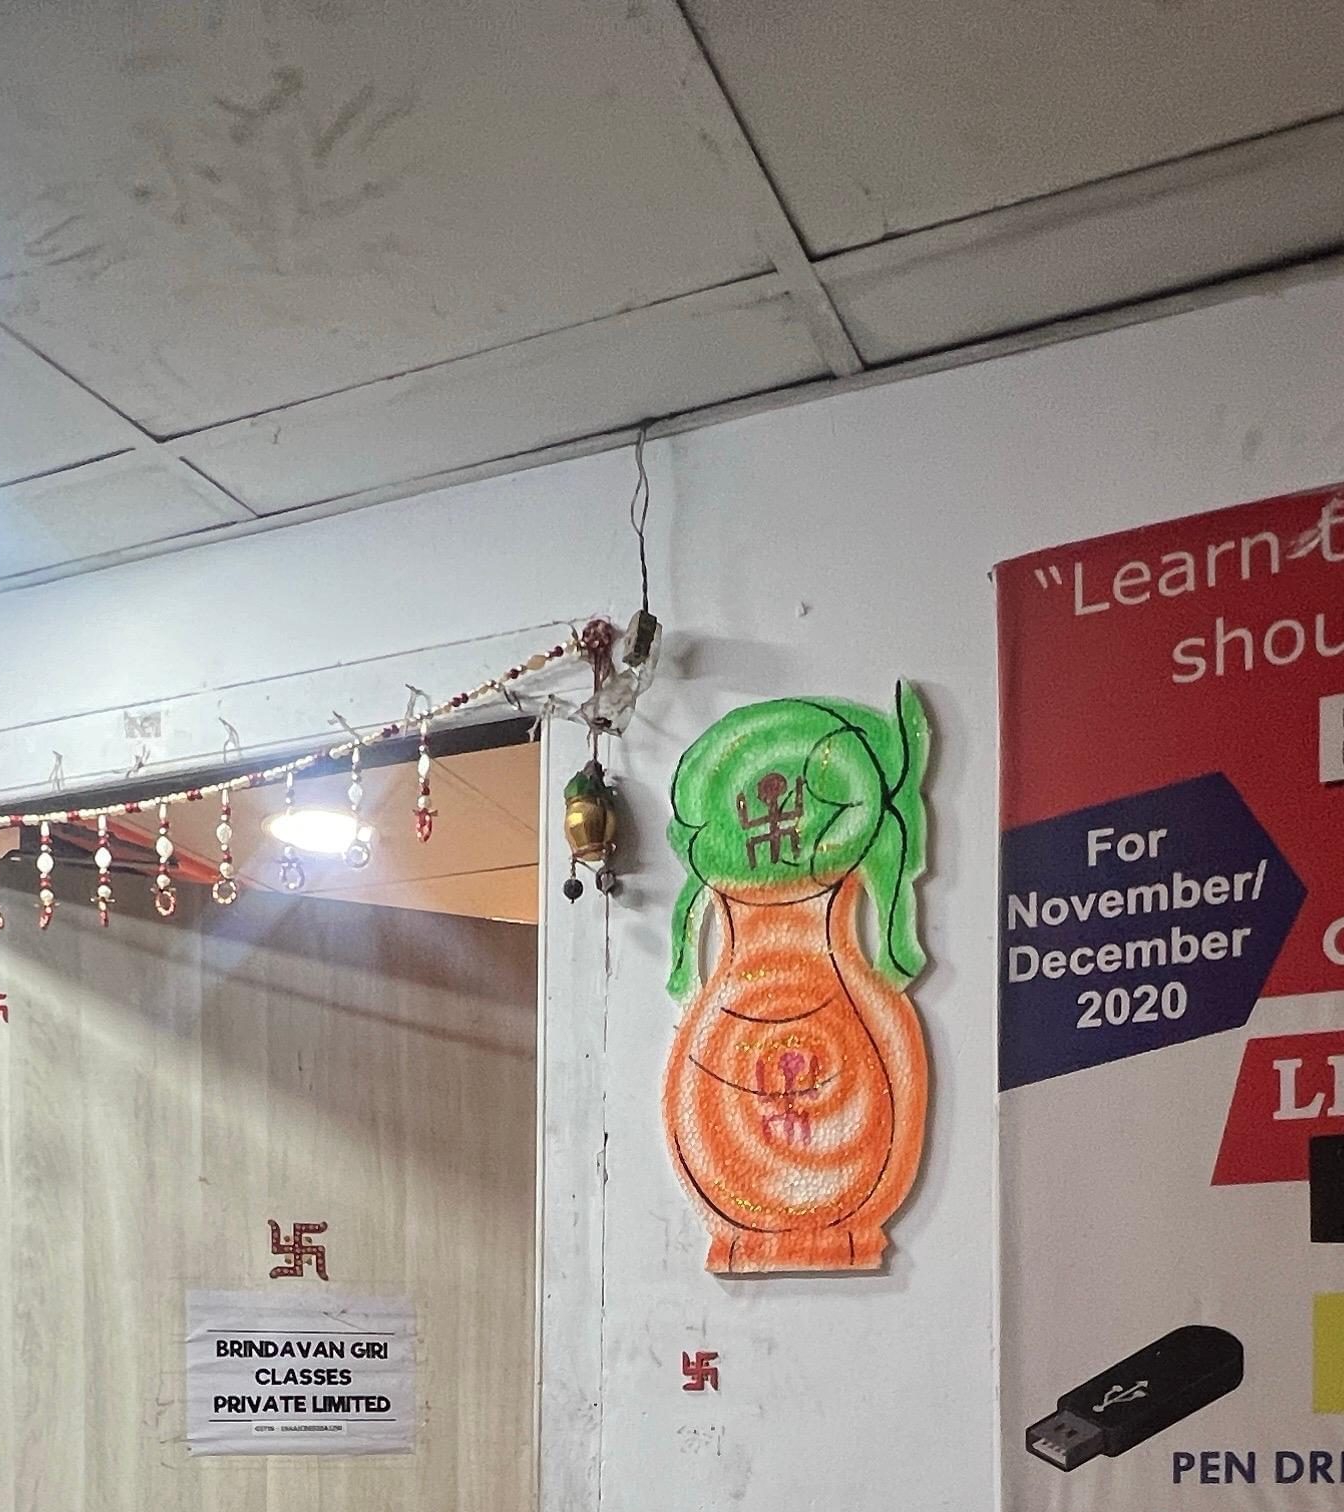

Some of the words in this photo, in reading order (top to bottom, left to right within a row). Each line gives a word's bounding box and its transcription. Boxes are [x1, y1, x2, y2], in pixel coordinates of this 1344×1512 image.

[1087, 826, 1168, 868] For
[1006, 860, 1269, 931] November/
[1006, 924, 1252, 984] December
[1076, 981, 1188, 1029] 2020
[216, 1340, 345, 1359] BRINDAVAN
[351, 1342, 389, 1360] GIRI
[255, 1368, 353, 1386] CLASSES
[213, 1395, 308, 1414] PRIVATE
[312, 1395, 392, 1414] LIMITED
[1172, 1450, 1256, 1485] PEN
